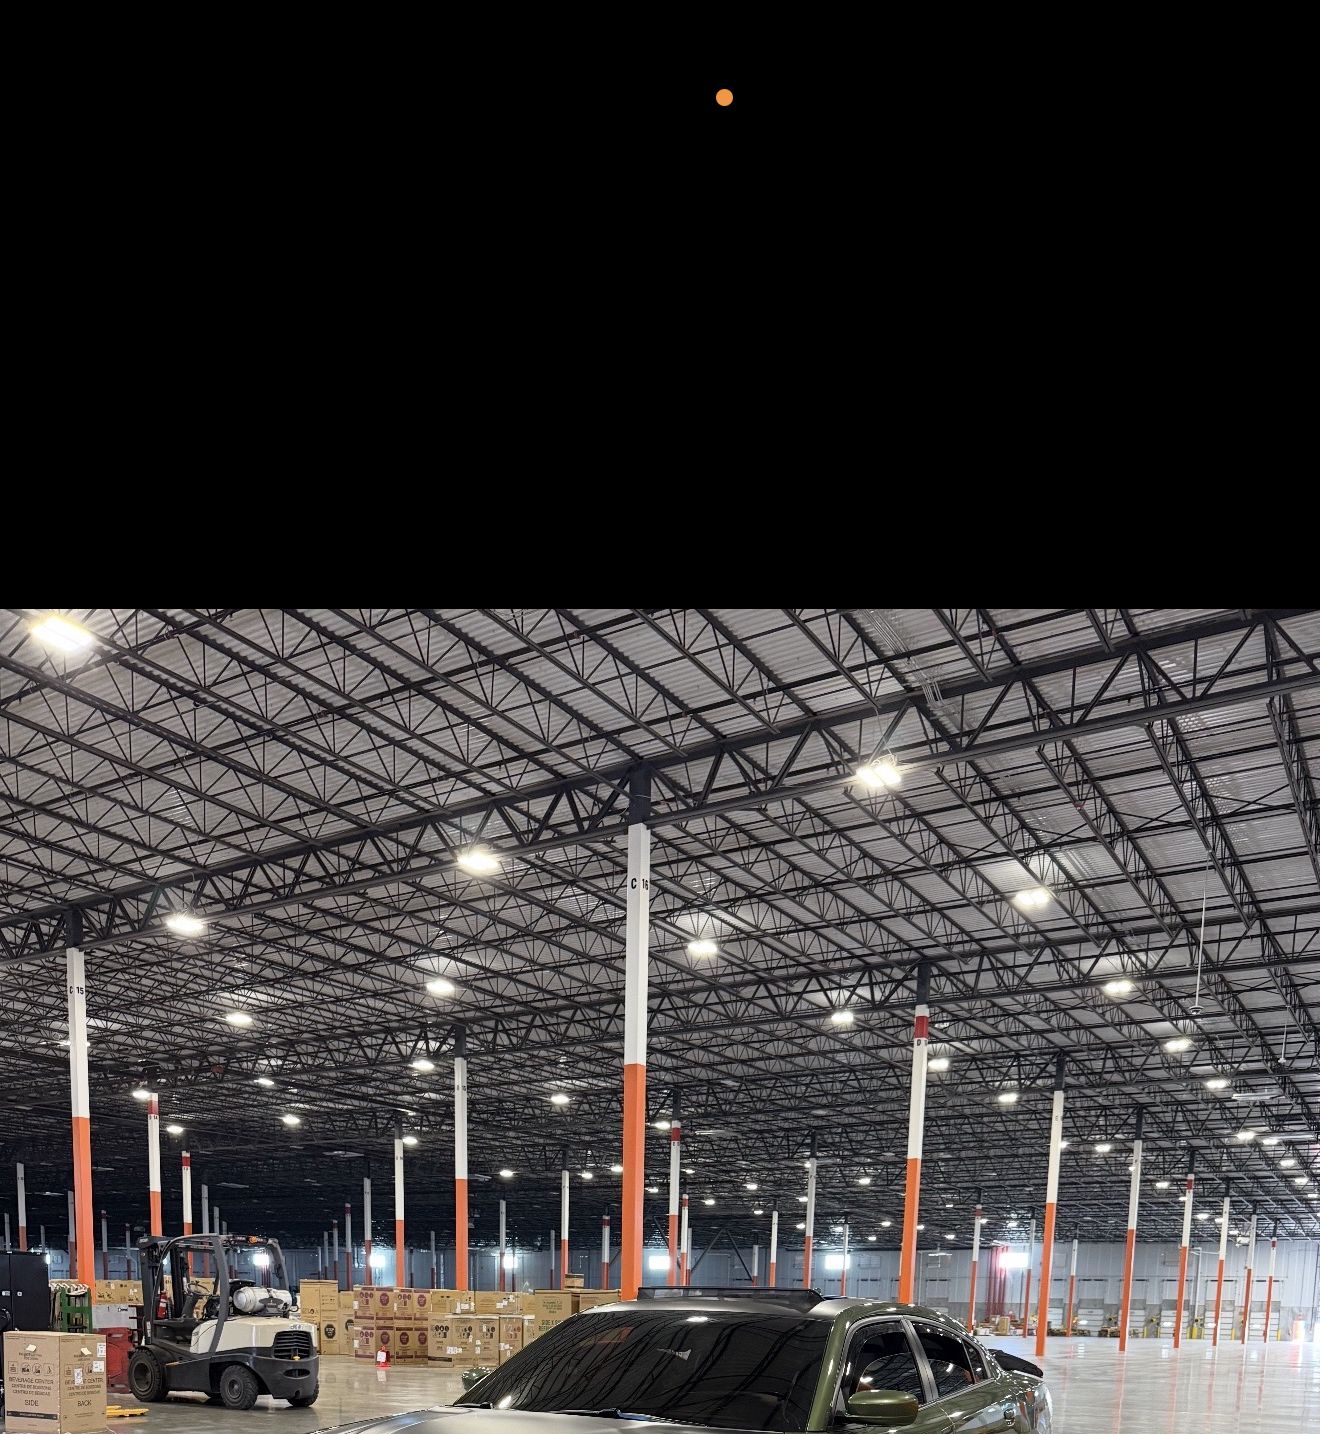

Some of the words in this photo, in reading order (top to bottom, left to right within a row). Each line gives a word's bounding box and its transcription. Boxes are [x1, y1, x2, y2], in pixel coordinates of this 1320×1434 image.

[631, 878, 637, 889] C
[642, 879, 649, 890] 16
[76, 986, 85, 995] 15
